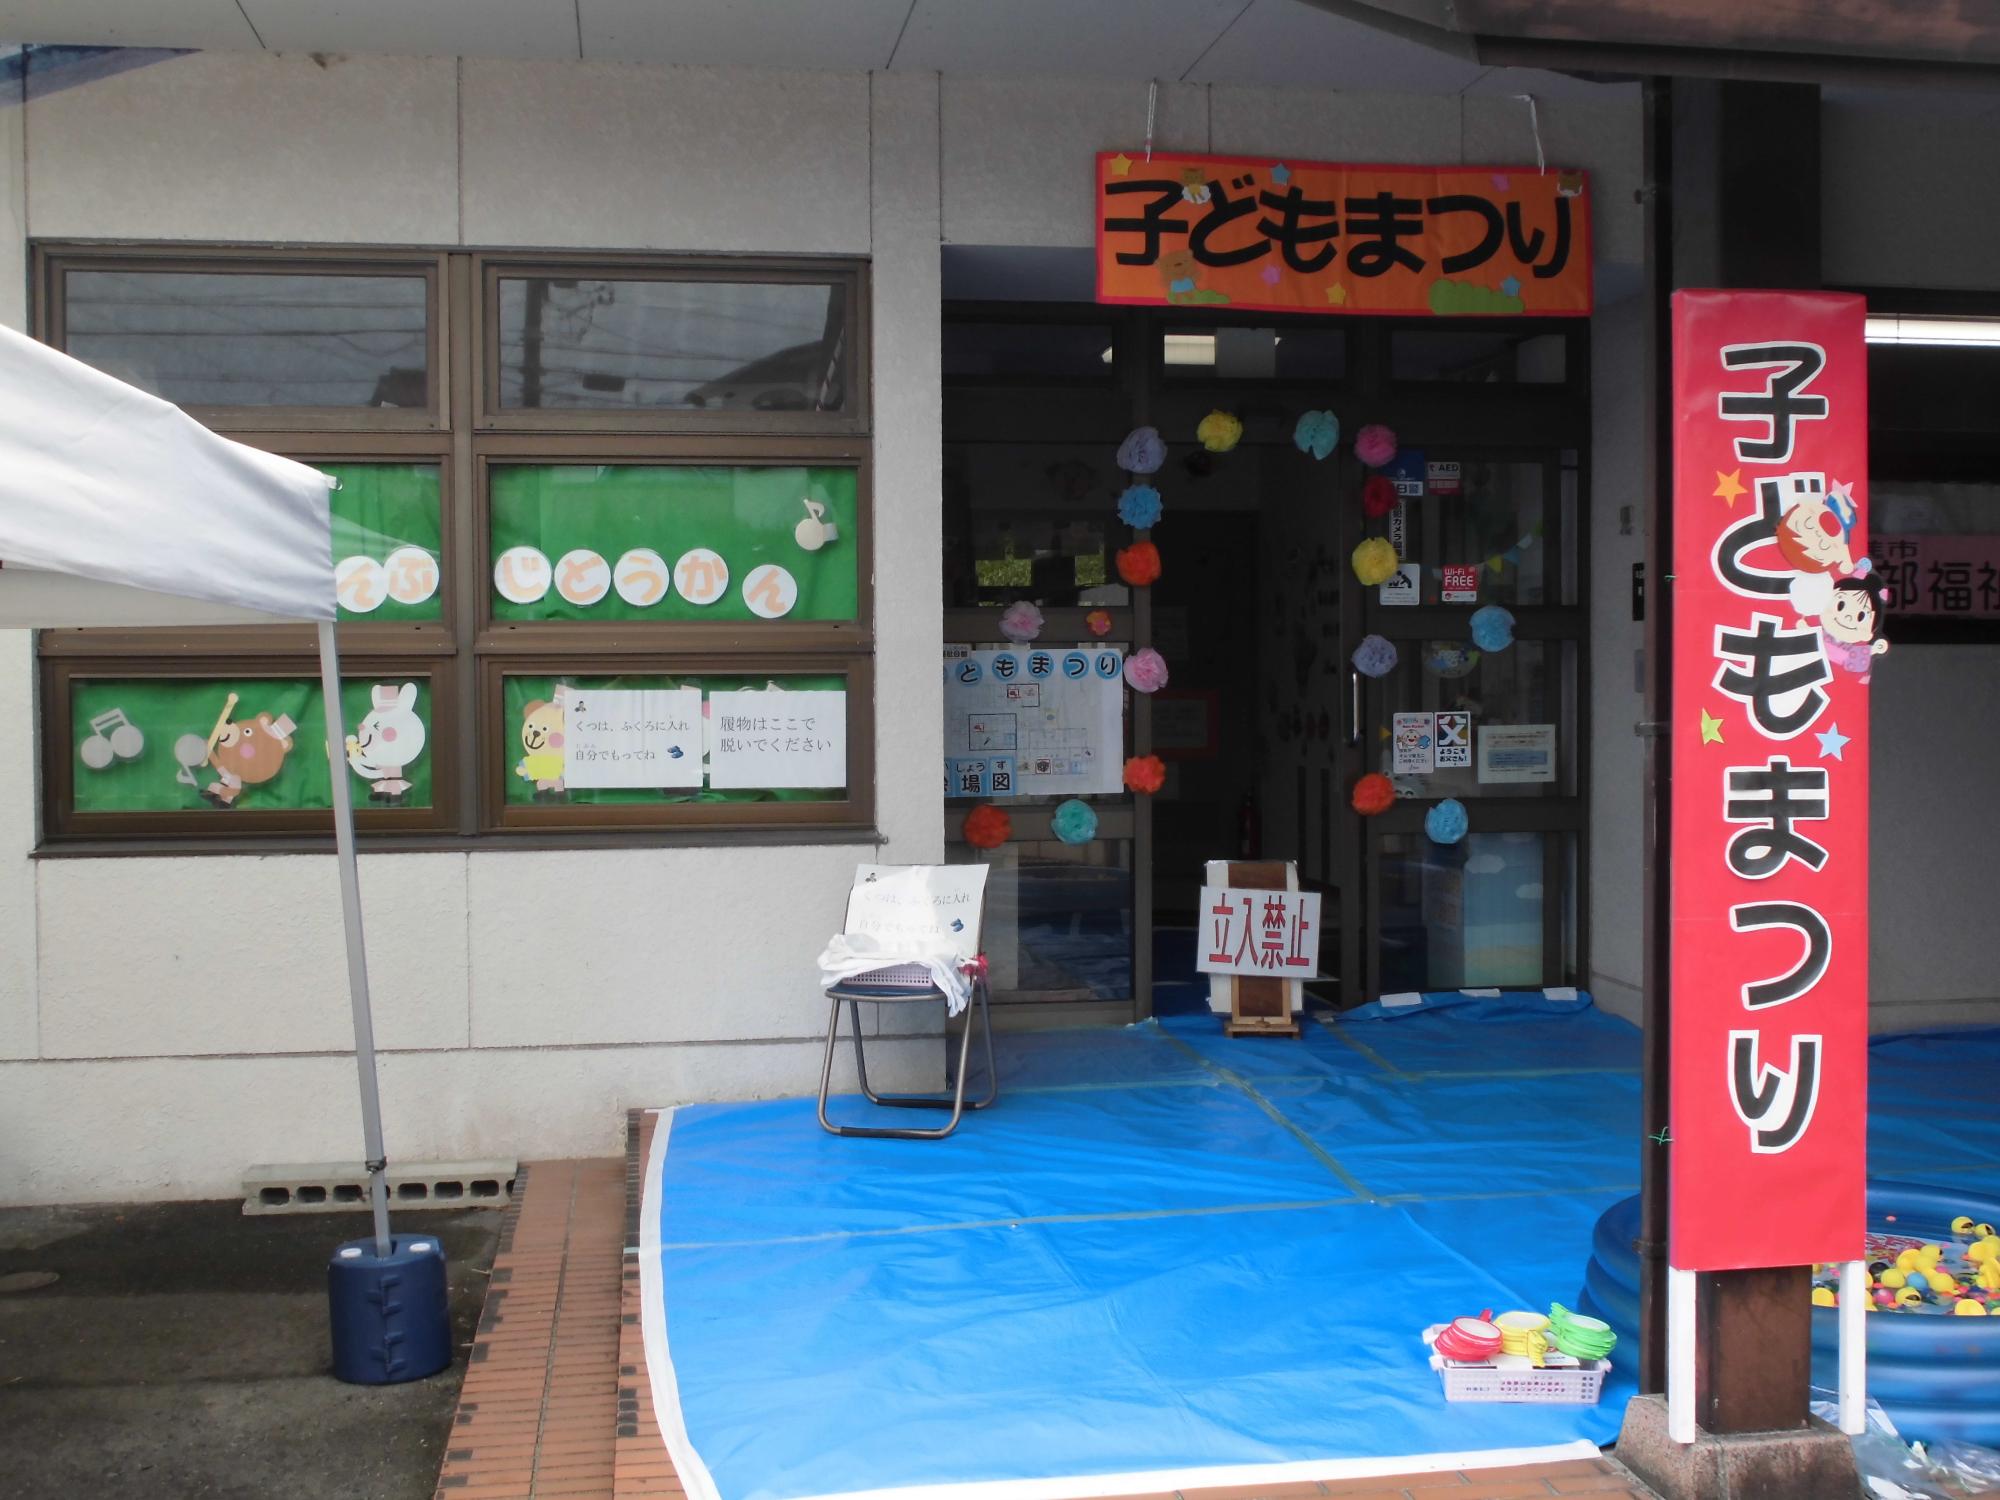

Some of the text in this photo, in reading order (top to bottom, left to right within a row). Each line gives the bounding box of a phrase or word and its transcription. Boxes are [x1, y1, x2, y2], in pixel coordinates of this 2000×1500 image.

[1104, 173, 1571, 278] 子どもまつり
[1438, 463, 1459, 471] AED
[1444, 567, 1465, 576] Wi-Fi
[1444, 575, 1474, 587] FREE
[720, 716, 816, 731] 履物はここで
[719, 738, 832, 752] 脱いでください
[1709, 341, 1833, 1154] 子どもまつり
[575, 748, 656, 762] 自分でもってね
[1208, 893, 1310, 969] 立入禁止
